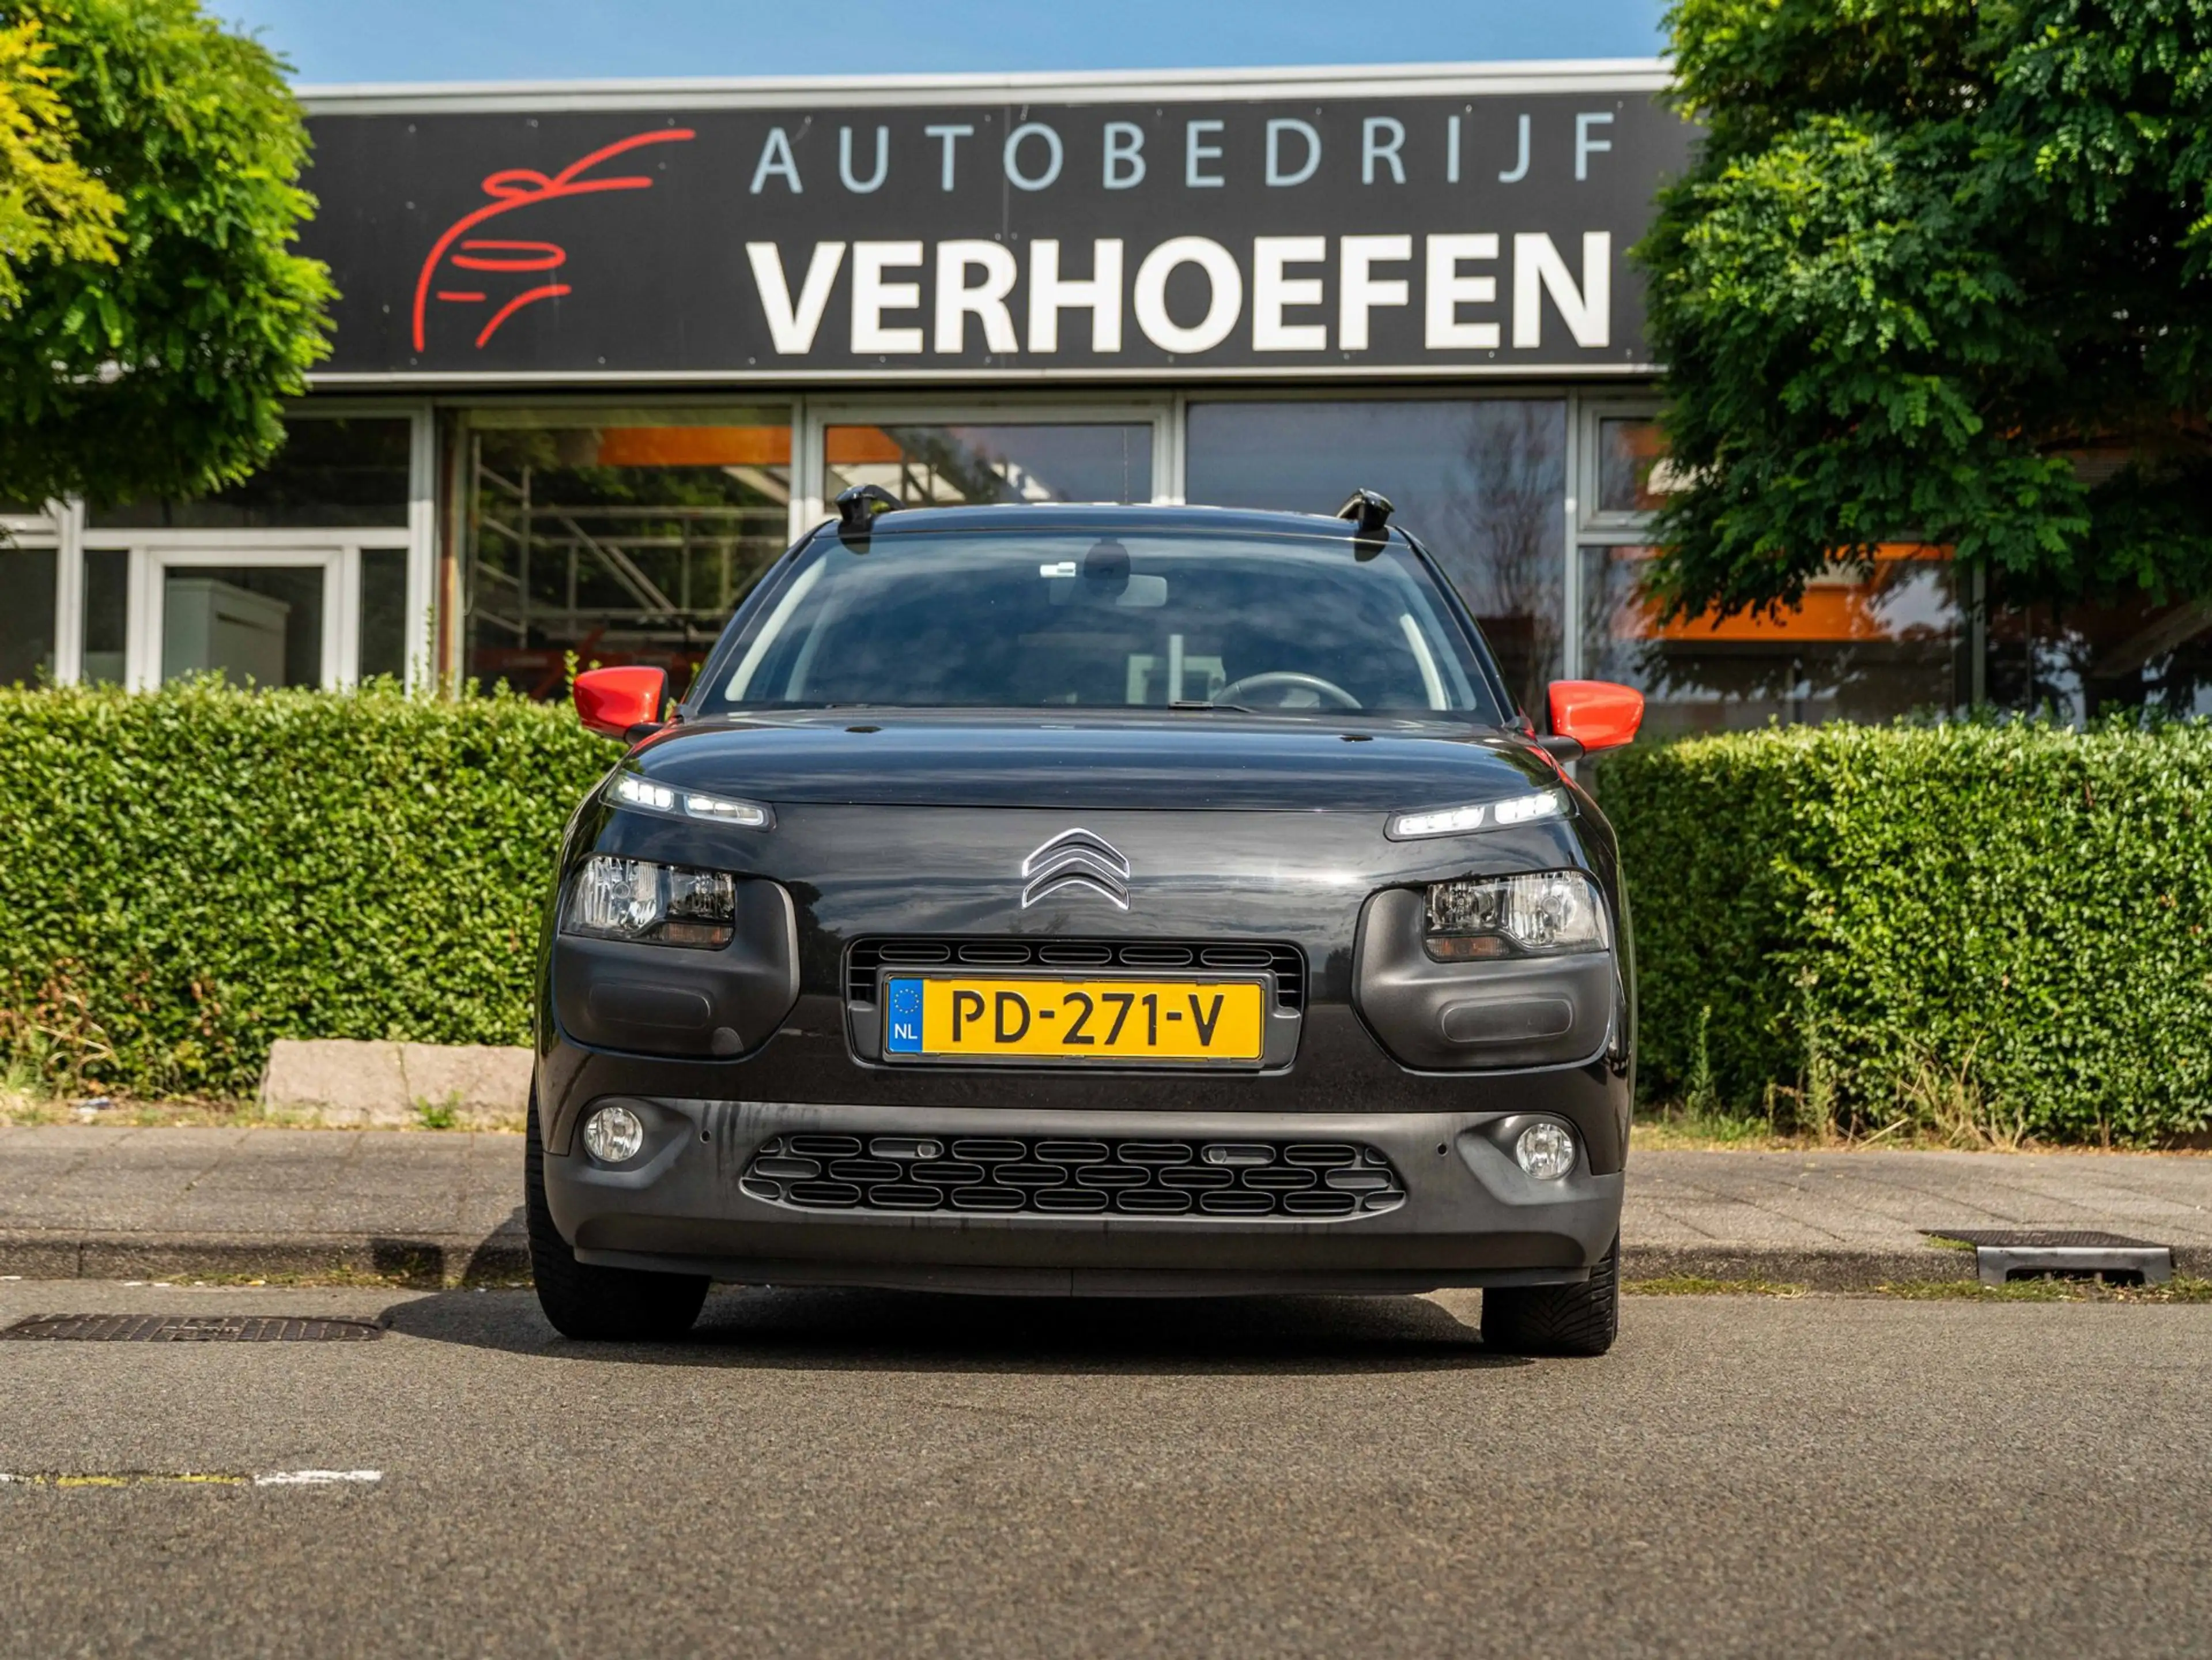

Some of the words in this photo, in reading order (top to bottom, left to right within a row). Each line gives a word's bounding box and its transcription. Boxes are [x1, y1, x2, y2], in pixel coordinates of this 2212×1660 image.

[750, 112, 1614, 194] AUTOBEDRIJF
[746, 232, 1611, 354] VERHOEFEN
[894, 1023, 918, 1039] NL
[952, 990, 1224, 1046] PD-271-V
